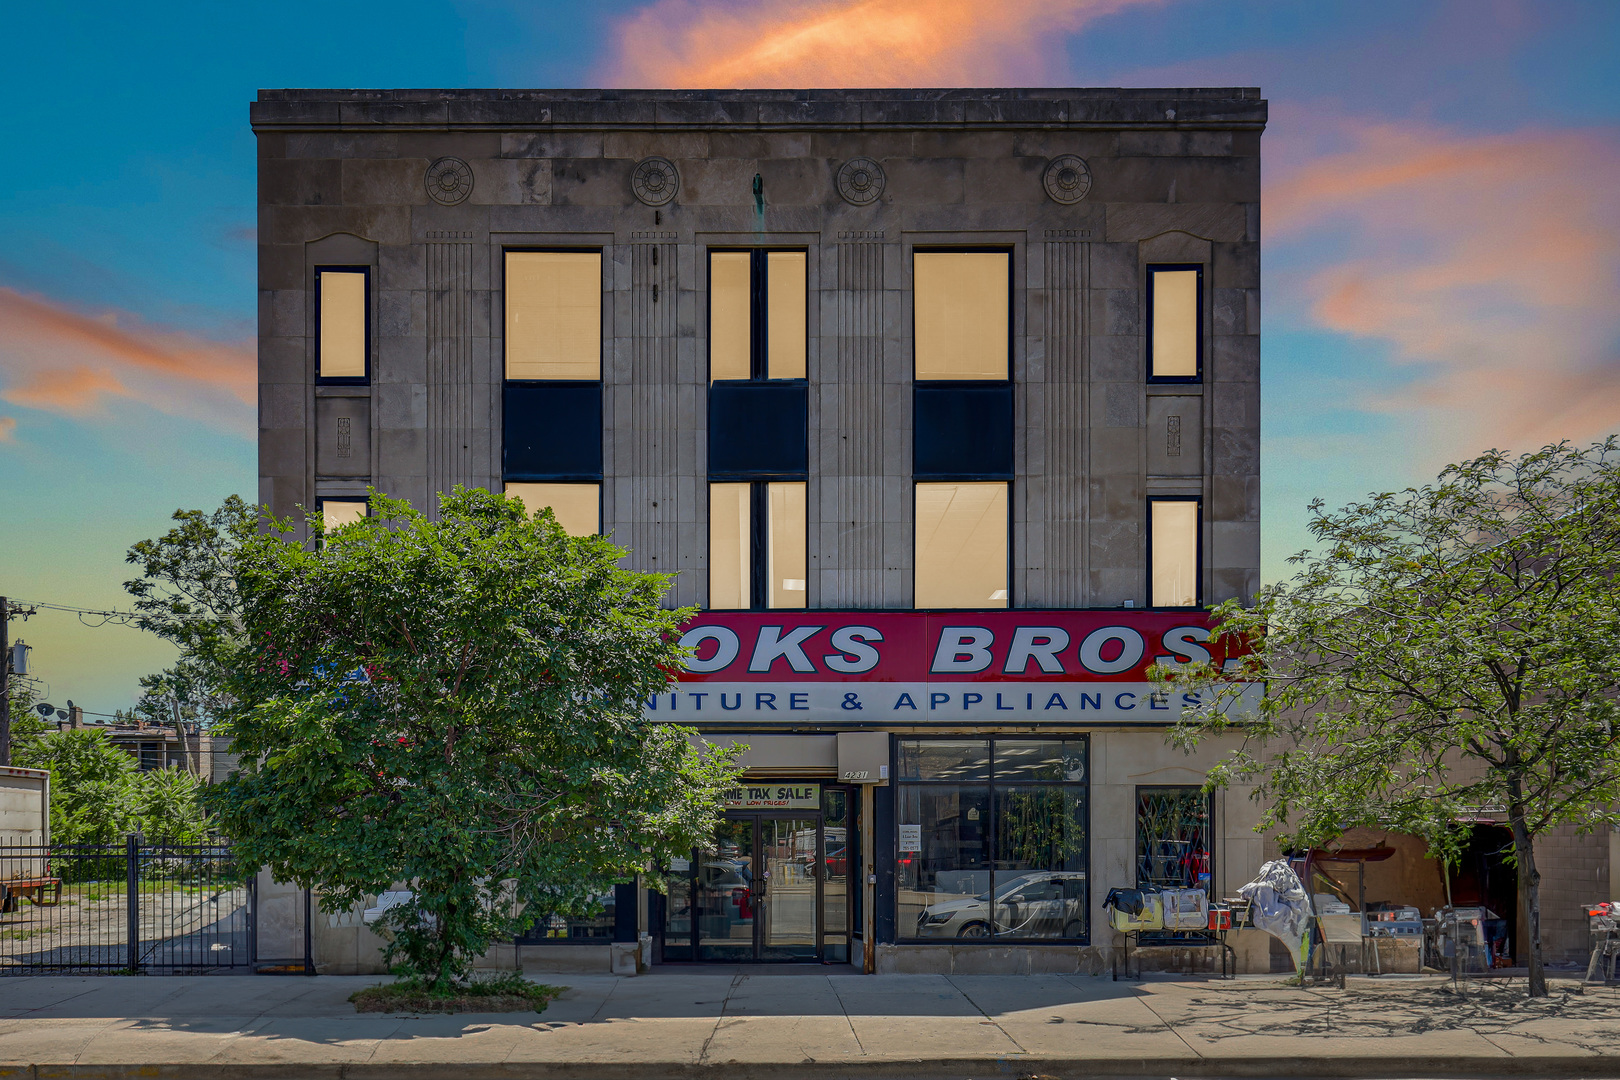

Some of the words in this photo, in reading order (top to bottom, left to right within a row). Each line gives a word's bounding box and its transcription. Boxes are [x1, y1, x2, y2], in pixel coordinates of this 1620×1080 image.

[678, 625, 885, 674] OKS
[604, 692, 810, 711] NITURE
[841, 692, 863, 711] &
[893, 692, 1202, 711] APPLIANCES
[747, 787, 770, 800] TAX
[777, 787, 813, 800] SALE
